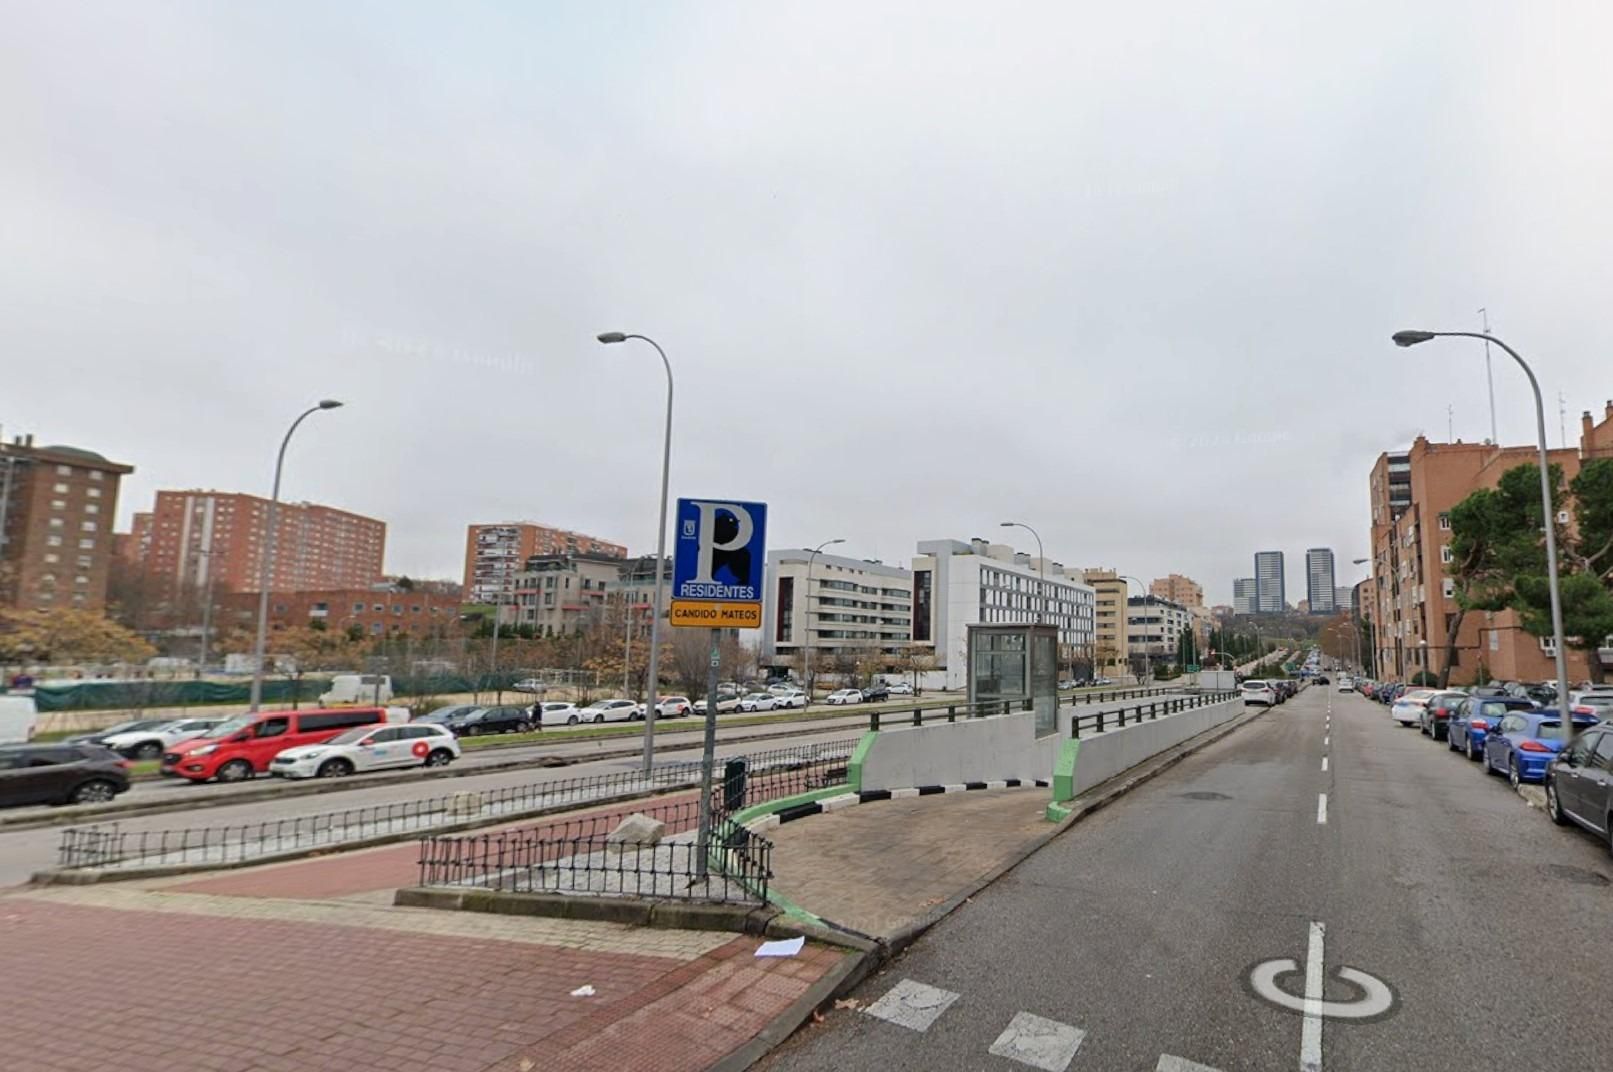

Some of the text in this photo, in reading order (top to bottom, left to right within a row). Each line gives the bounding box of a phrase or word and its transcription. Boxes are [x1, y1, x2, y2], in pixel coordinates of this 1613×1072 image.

[685, 501, 754, 584] P
[680, 584, 754, 598] RESIDENTES
[675, 609, 757, 620] CANDIDO MATEOS
